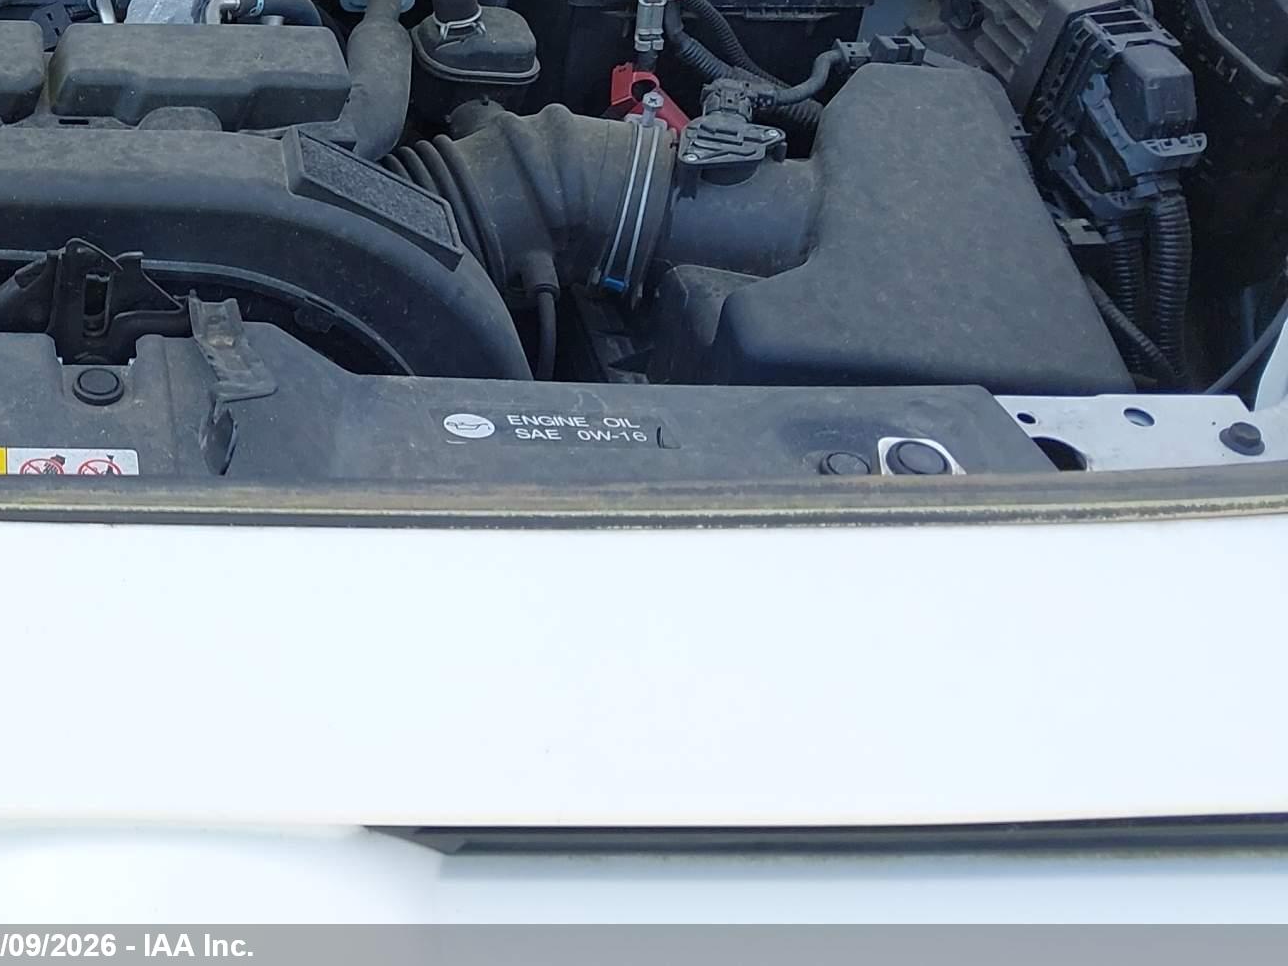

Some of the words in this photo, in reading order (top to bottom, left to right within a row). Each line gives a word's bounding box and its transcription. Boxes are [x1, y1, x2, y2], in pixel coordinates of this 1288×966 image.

[506, 415, 590, 428] ENGINE
[602, 417, 641, 429] OIL
[514, 428, 562, 440] SAE
[577, 430, 648, 442] 0W-16
